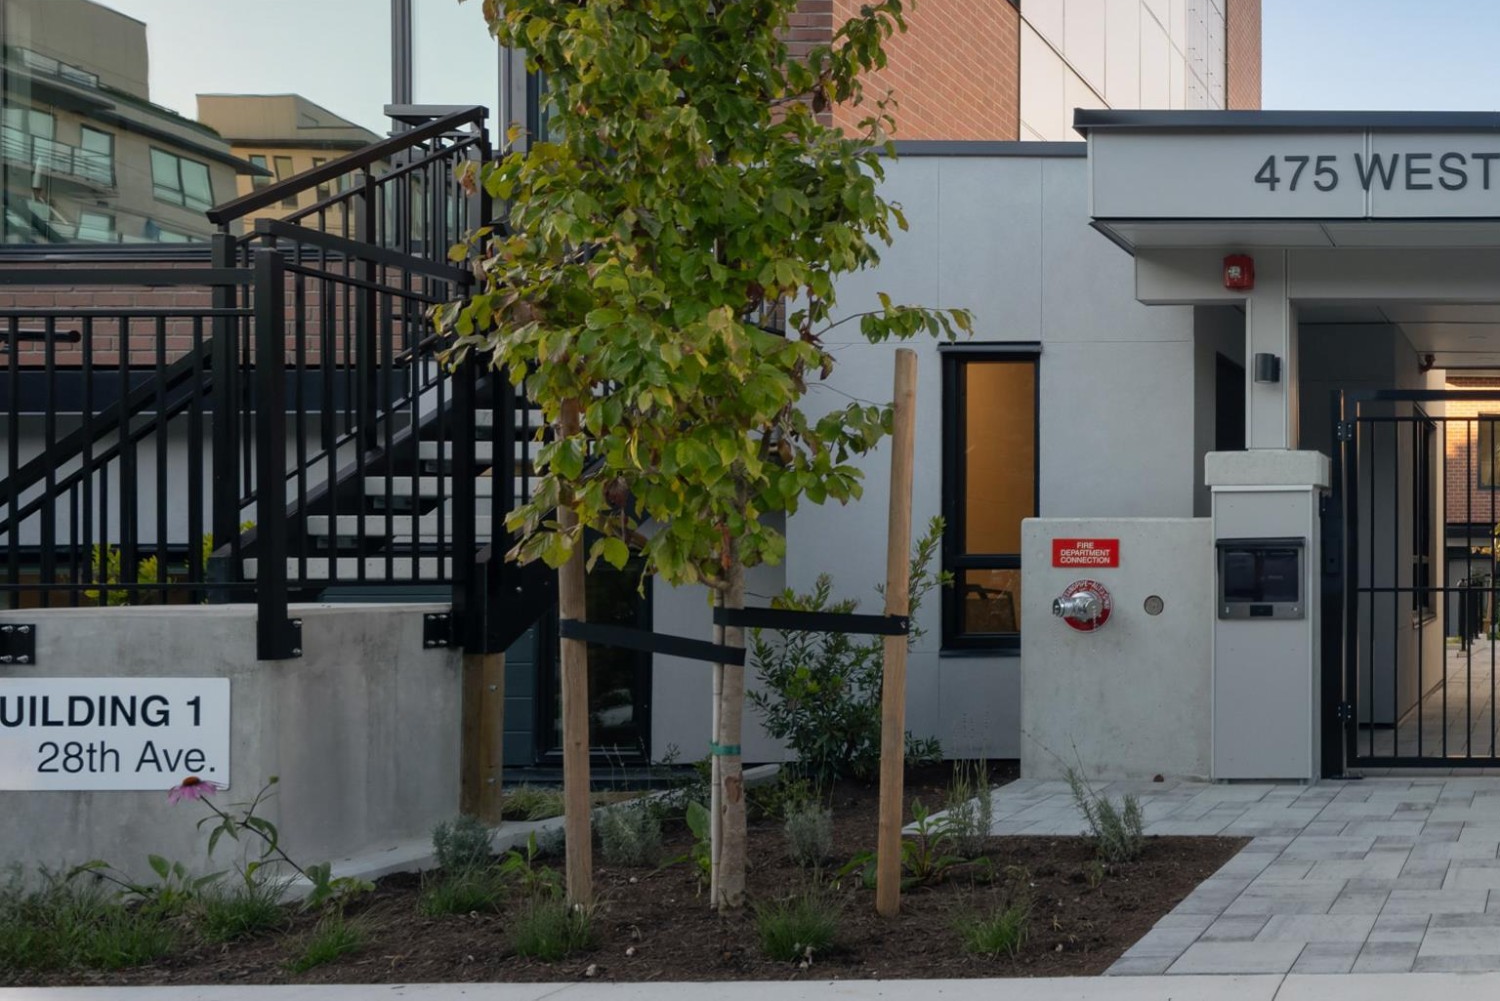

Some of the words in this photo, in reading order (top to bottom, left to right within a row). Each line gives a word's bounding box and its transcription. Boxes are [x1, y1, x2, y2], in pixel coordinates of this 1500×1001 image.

[1254, 154, 1340, 192] 475
[1060, 556, 1111, 564] CONNECTION
[1076, 541, 1094, 549] FIRE
[186, 695, 201, 727] 1
[37, 740, 121, 774] 28th
[135, 740, 216, 773] Ave.
